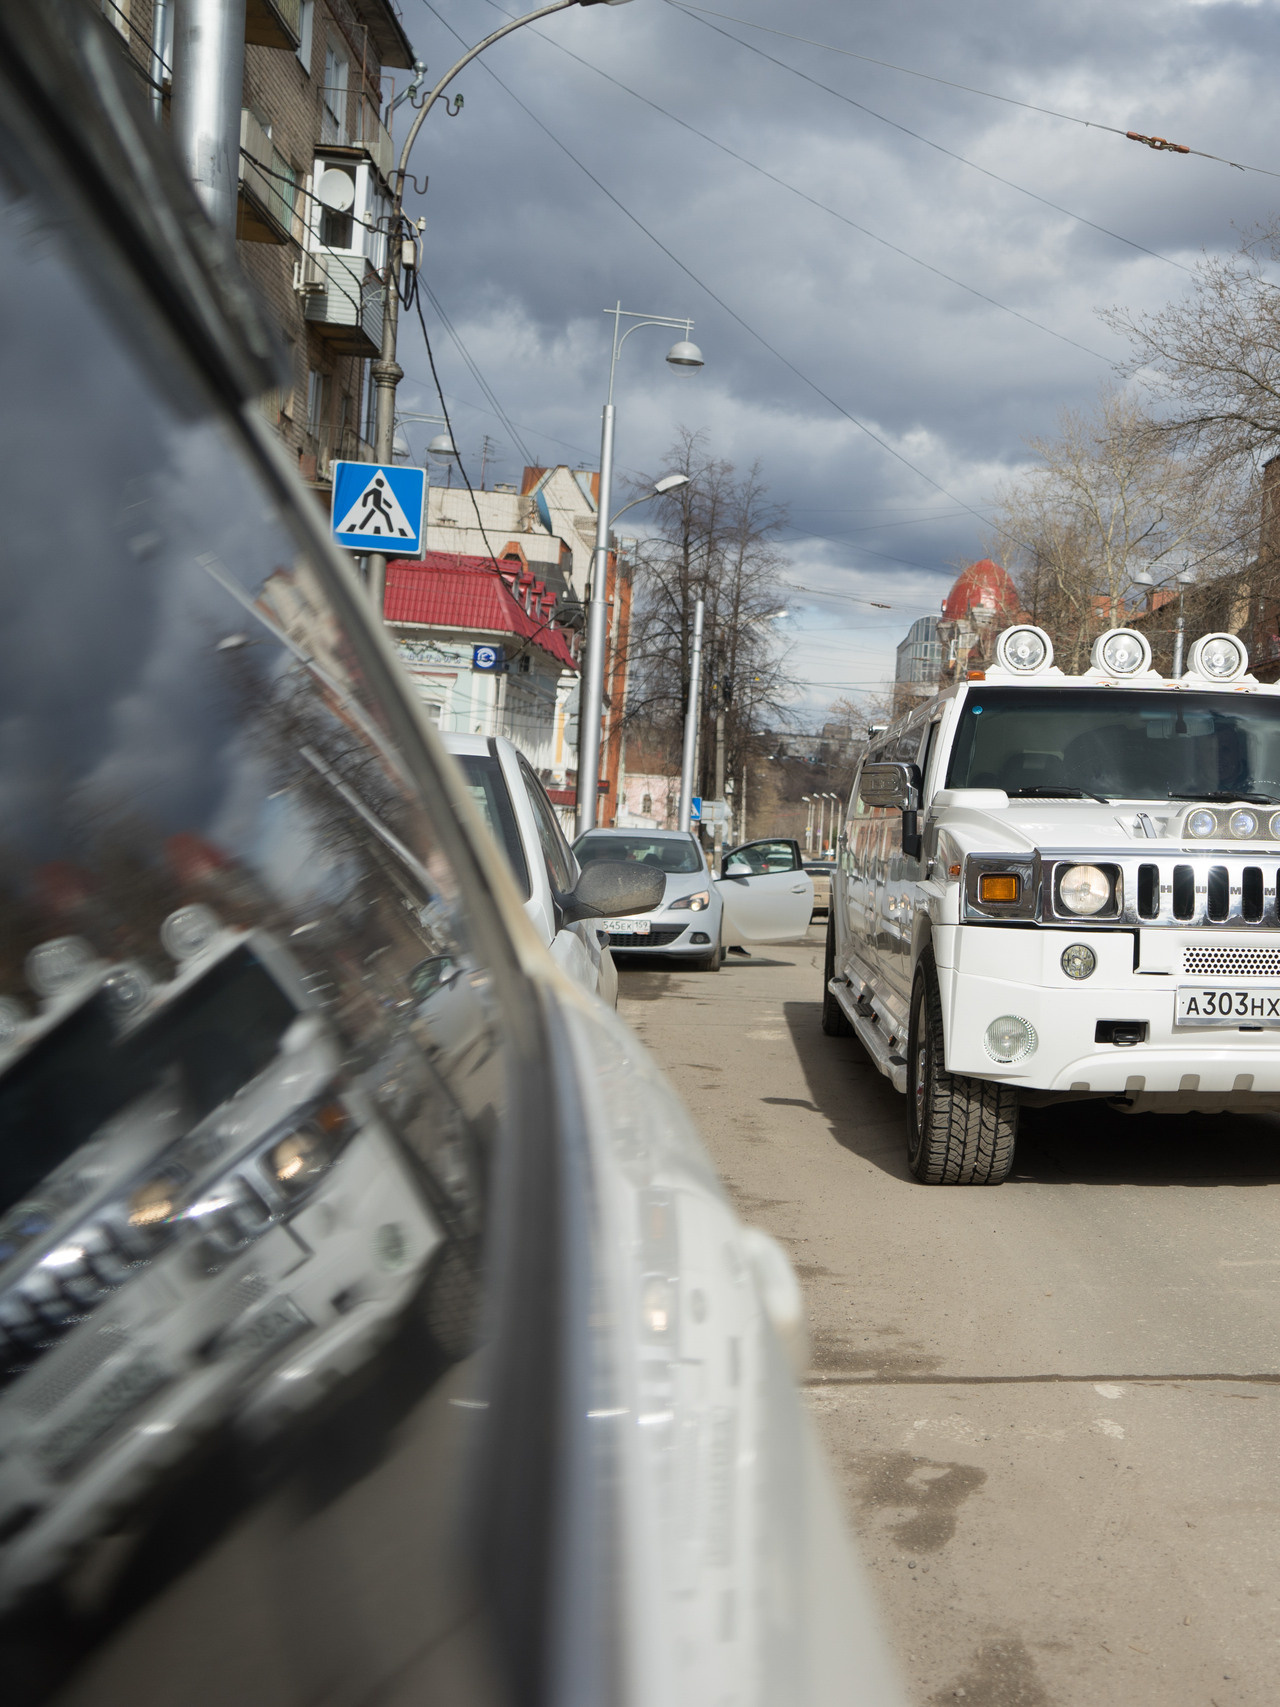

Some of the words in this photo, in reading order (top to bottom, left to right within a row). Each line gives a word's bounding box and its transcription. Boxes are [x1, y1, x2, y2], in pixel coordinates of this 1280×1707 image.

[603, 921, 632, 930] 545ЕК
[635, 921, 648, 929] 159
[1186, 991, 1280, 1016] А303НХ
